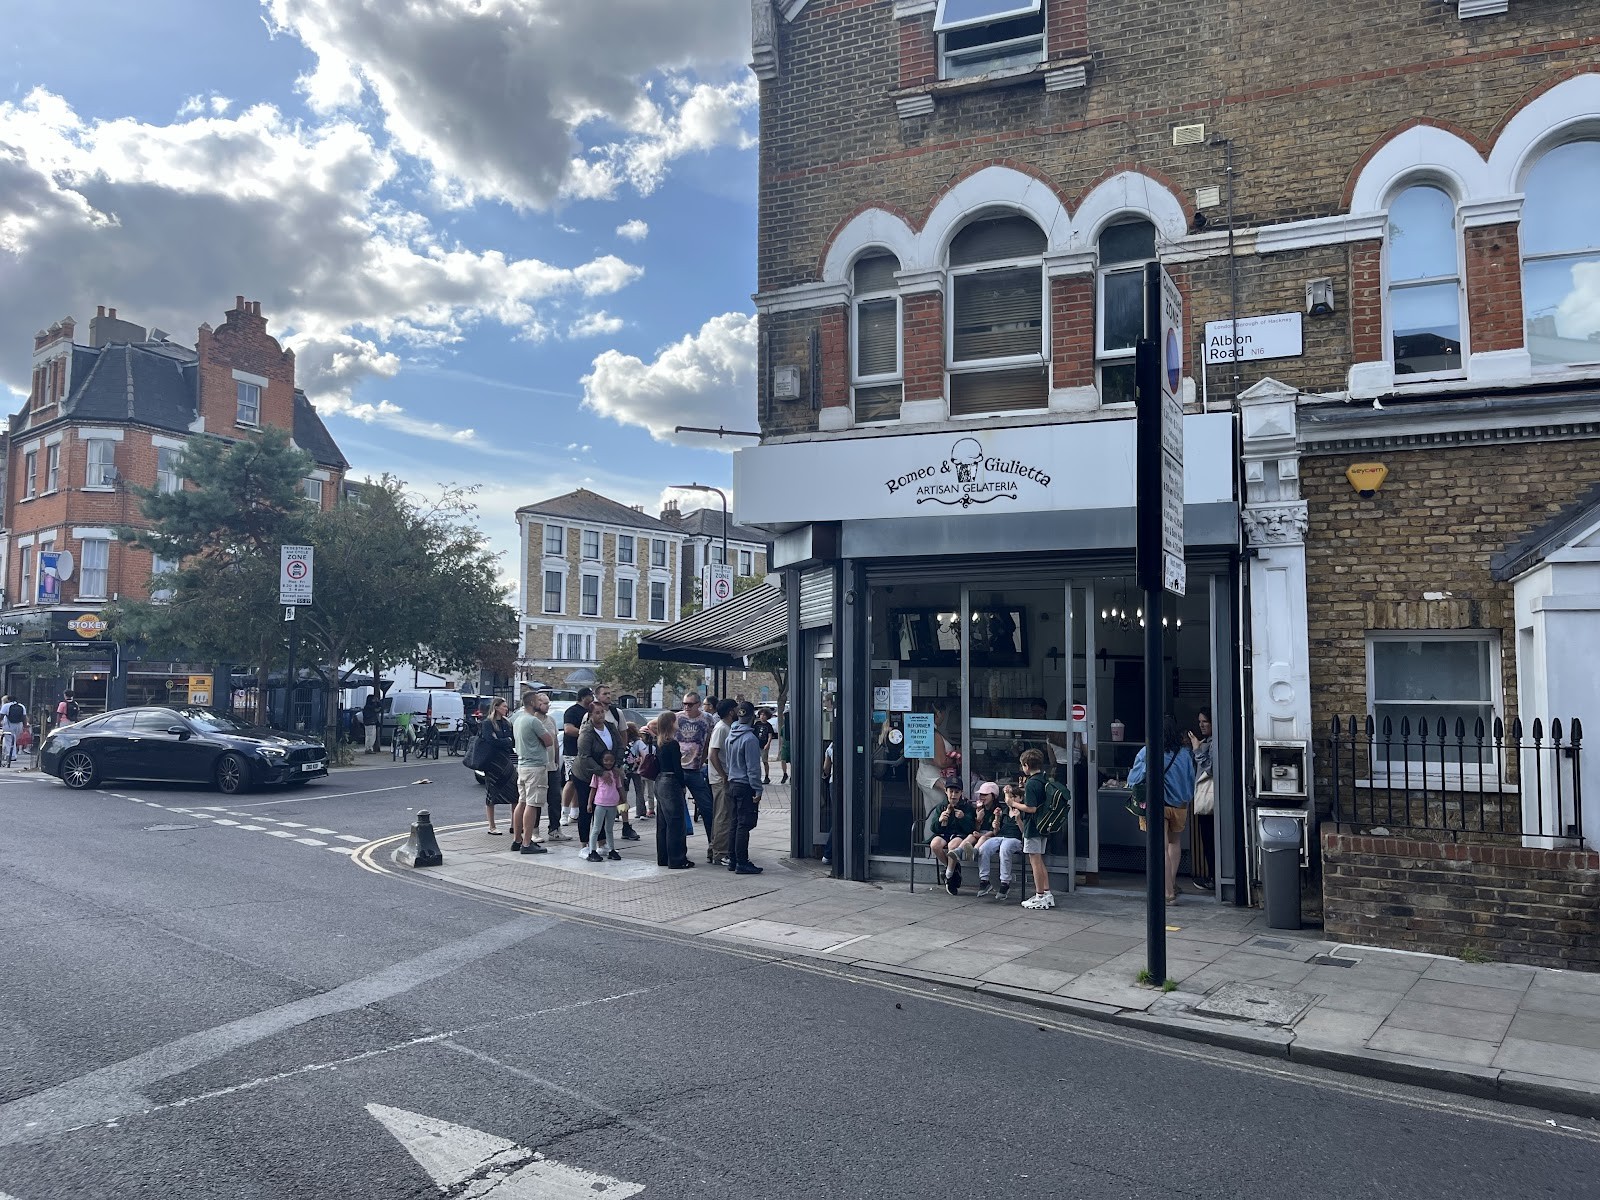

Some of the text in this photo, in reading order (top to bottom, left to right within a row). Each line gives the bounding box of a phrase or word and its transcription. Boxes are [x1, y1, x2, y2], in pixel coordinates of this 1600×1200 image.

[1163, 275, 1182, 313] Controlled
[1165, 297, 1179, 329] ZONE
[1210, 346, 1265, 360] Road N16
[885, 457, 1052, 494] Romeo & Giulietta
[916, 481, 1018, 496] ARTISAN GELATERIA
[69, 621, 108, 629] STOKEY
